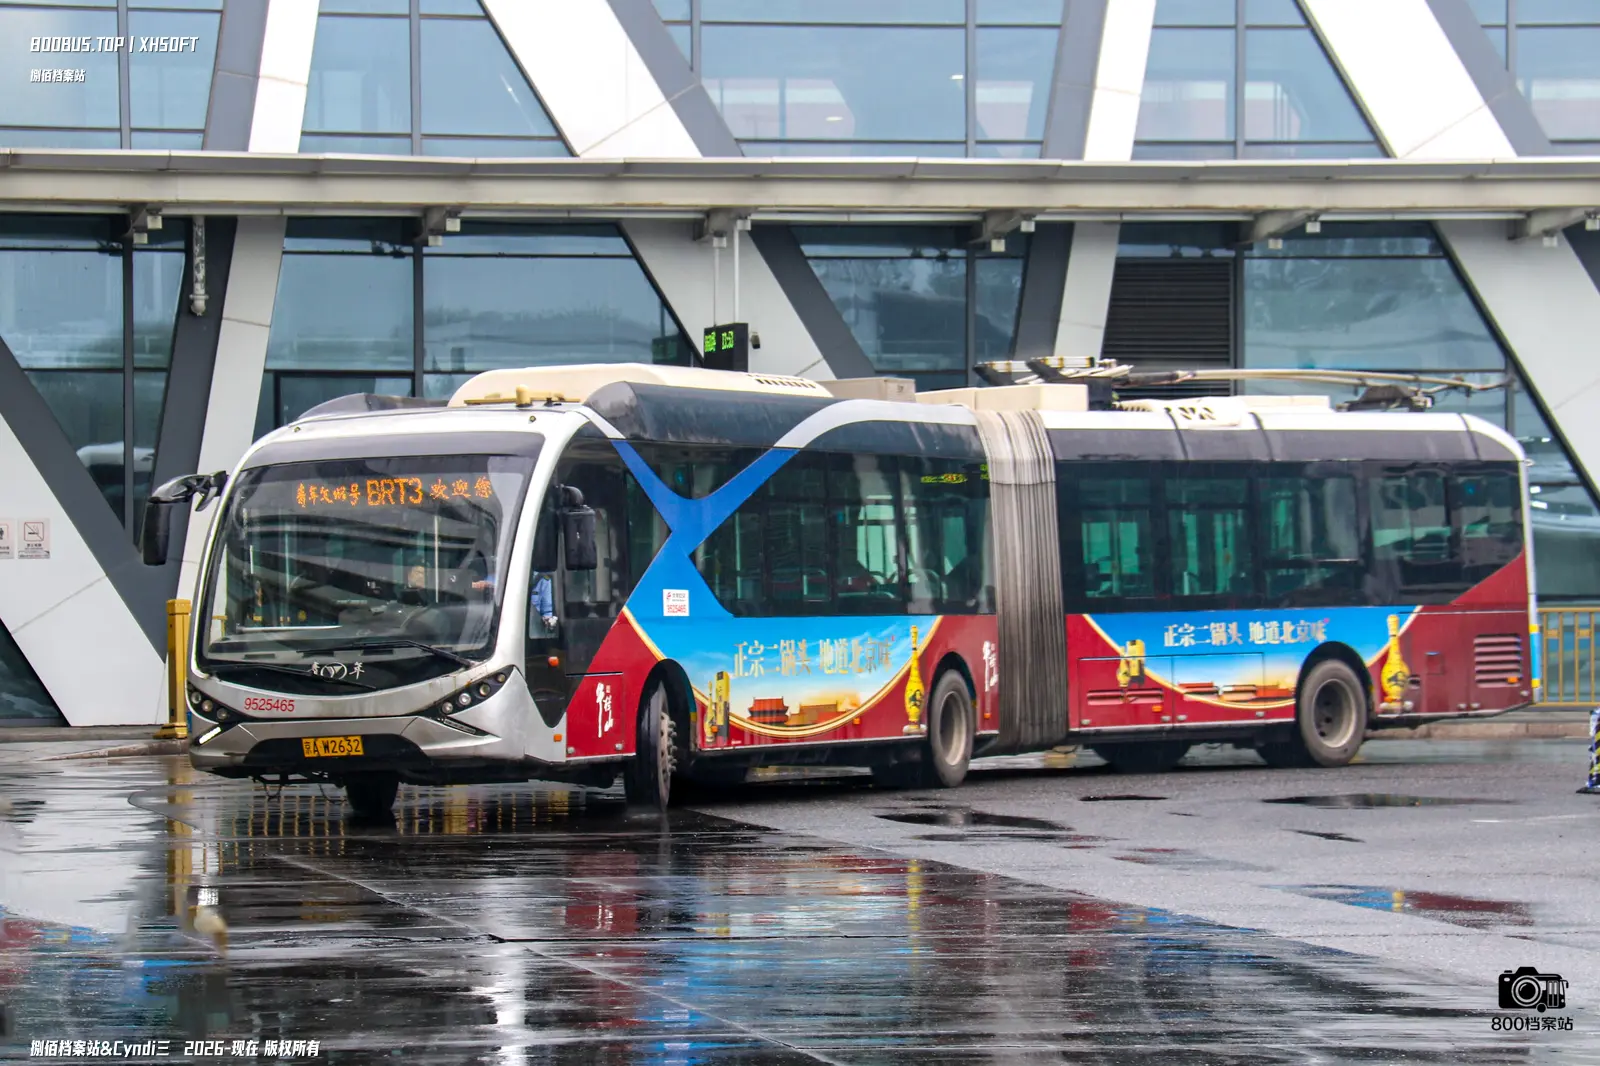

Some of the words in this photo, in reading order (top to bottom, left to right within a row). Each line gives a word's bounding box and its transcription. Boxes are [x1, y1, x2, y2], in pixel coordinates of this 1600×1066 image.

[366, 477, 424, 506] BRT3
[1163, 621, 1243, 647] 正宗二锅头
[733, 638, 811, 678] 正宗二锅头
[244, 697, 295, 712] 9525465
